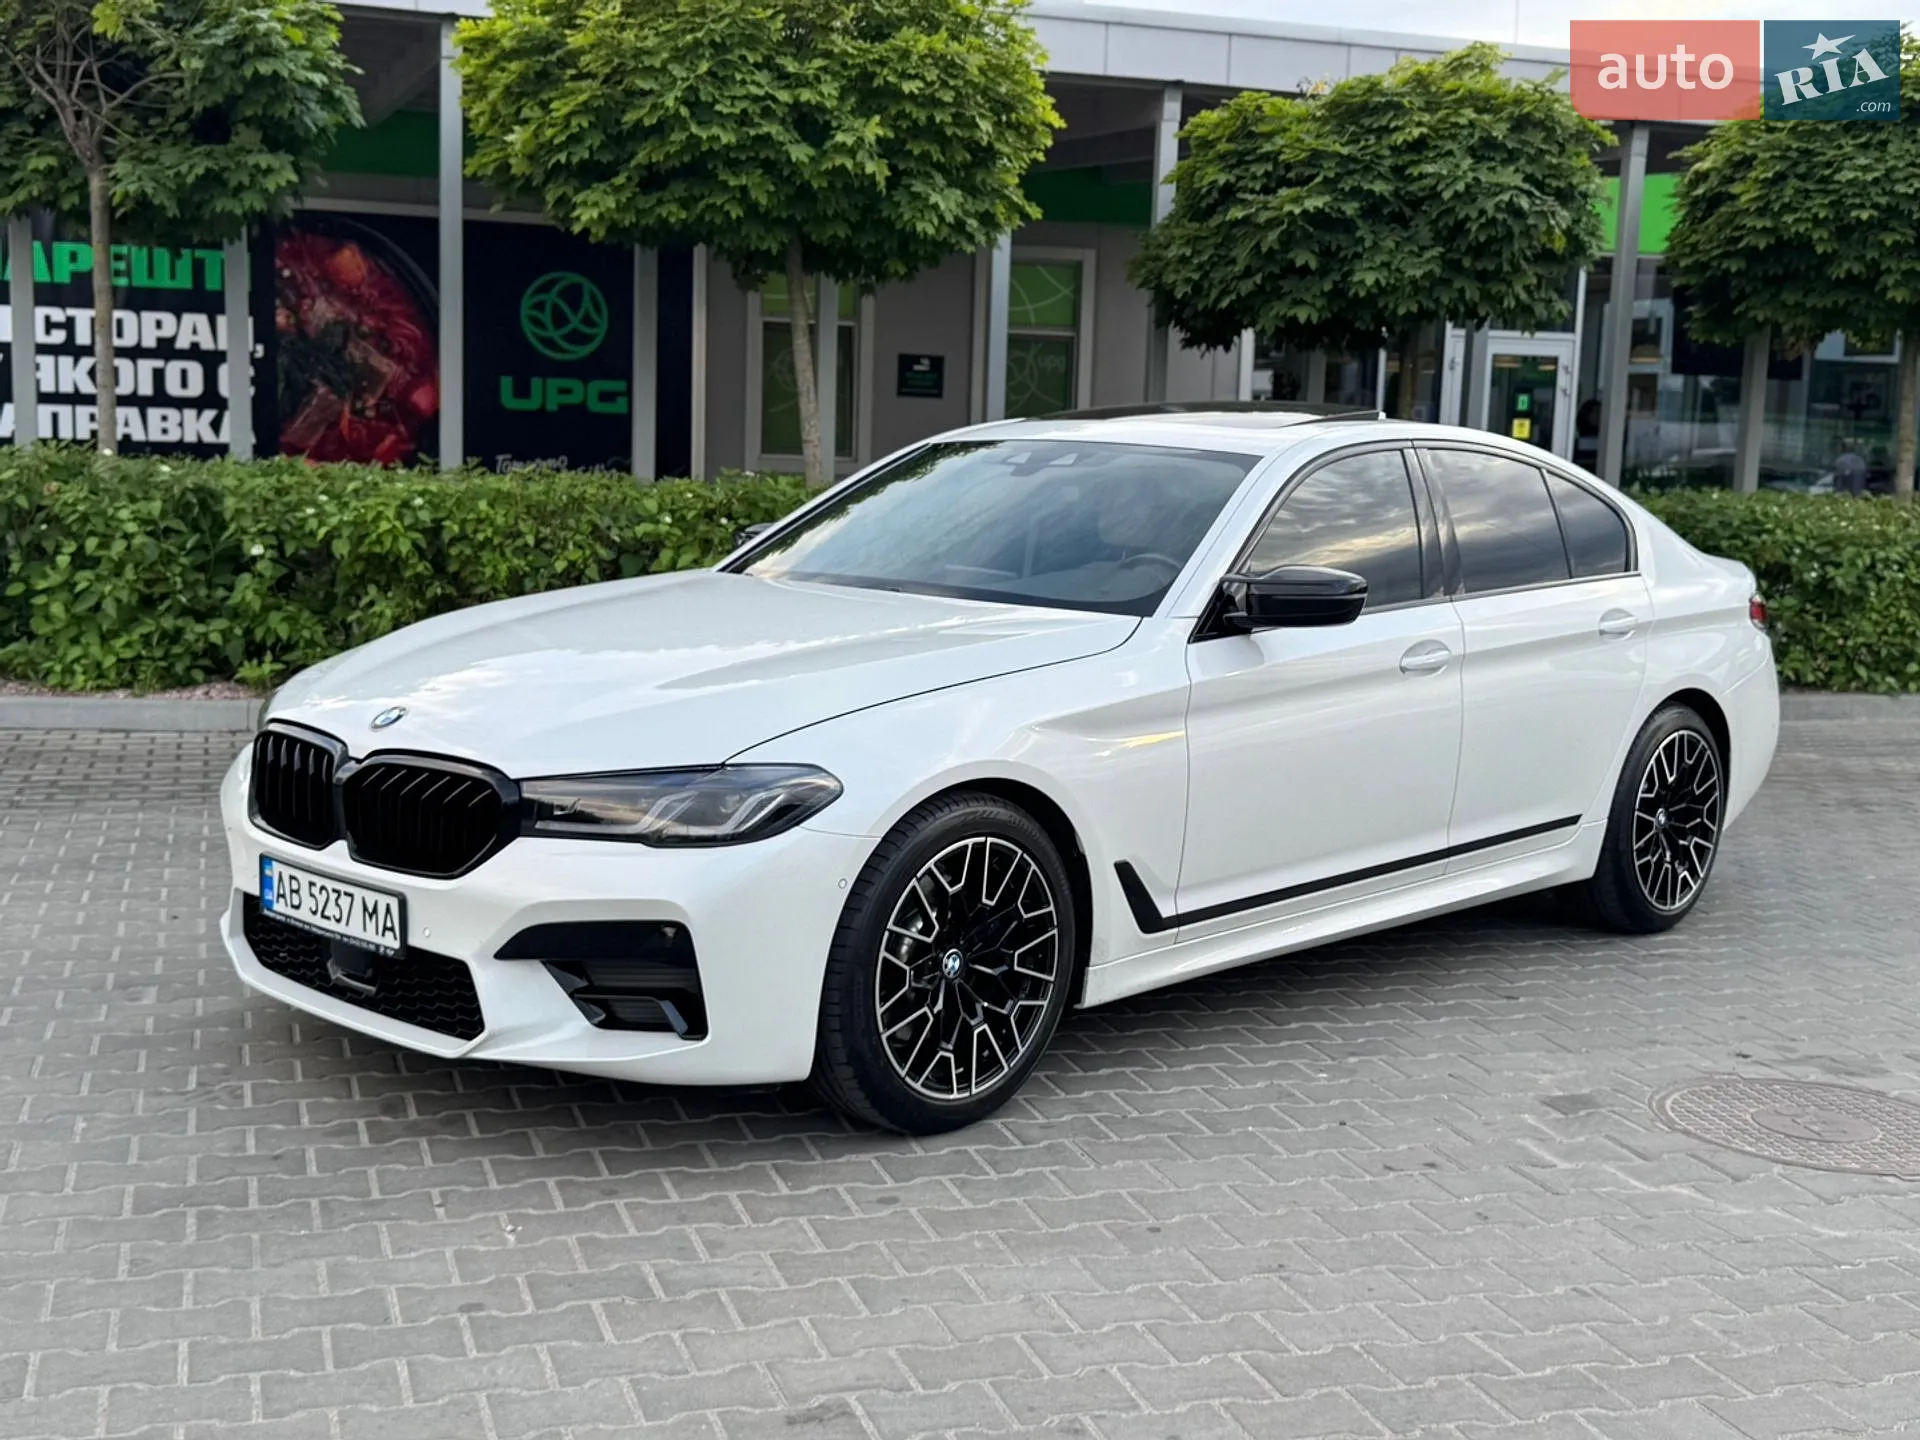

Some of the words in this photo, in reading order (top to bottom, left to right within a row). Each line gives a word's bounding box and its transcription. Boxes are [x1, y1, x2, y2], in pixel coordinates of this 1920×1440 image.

[0, 240, 251, 292] АРЕШТ
[500, 375, 628, 414] UPG
[276, 870, 302, 910] AB
[308, 880, 355, 927] 5237
[362, 895, 397, 941] MA
